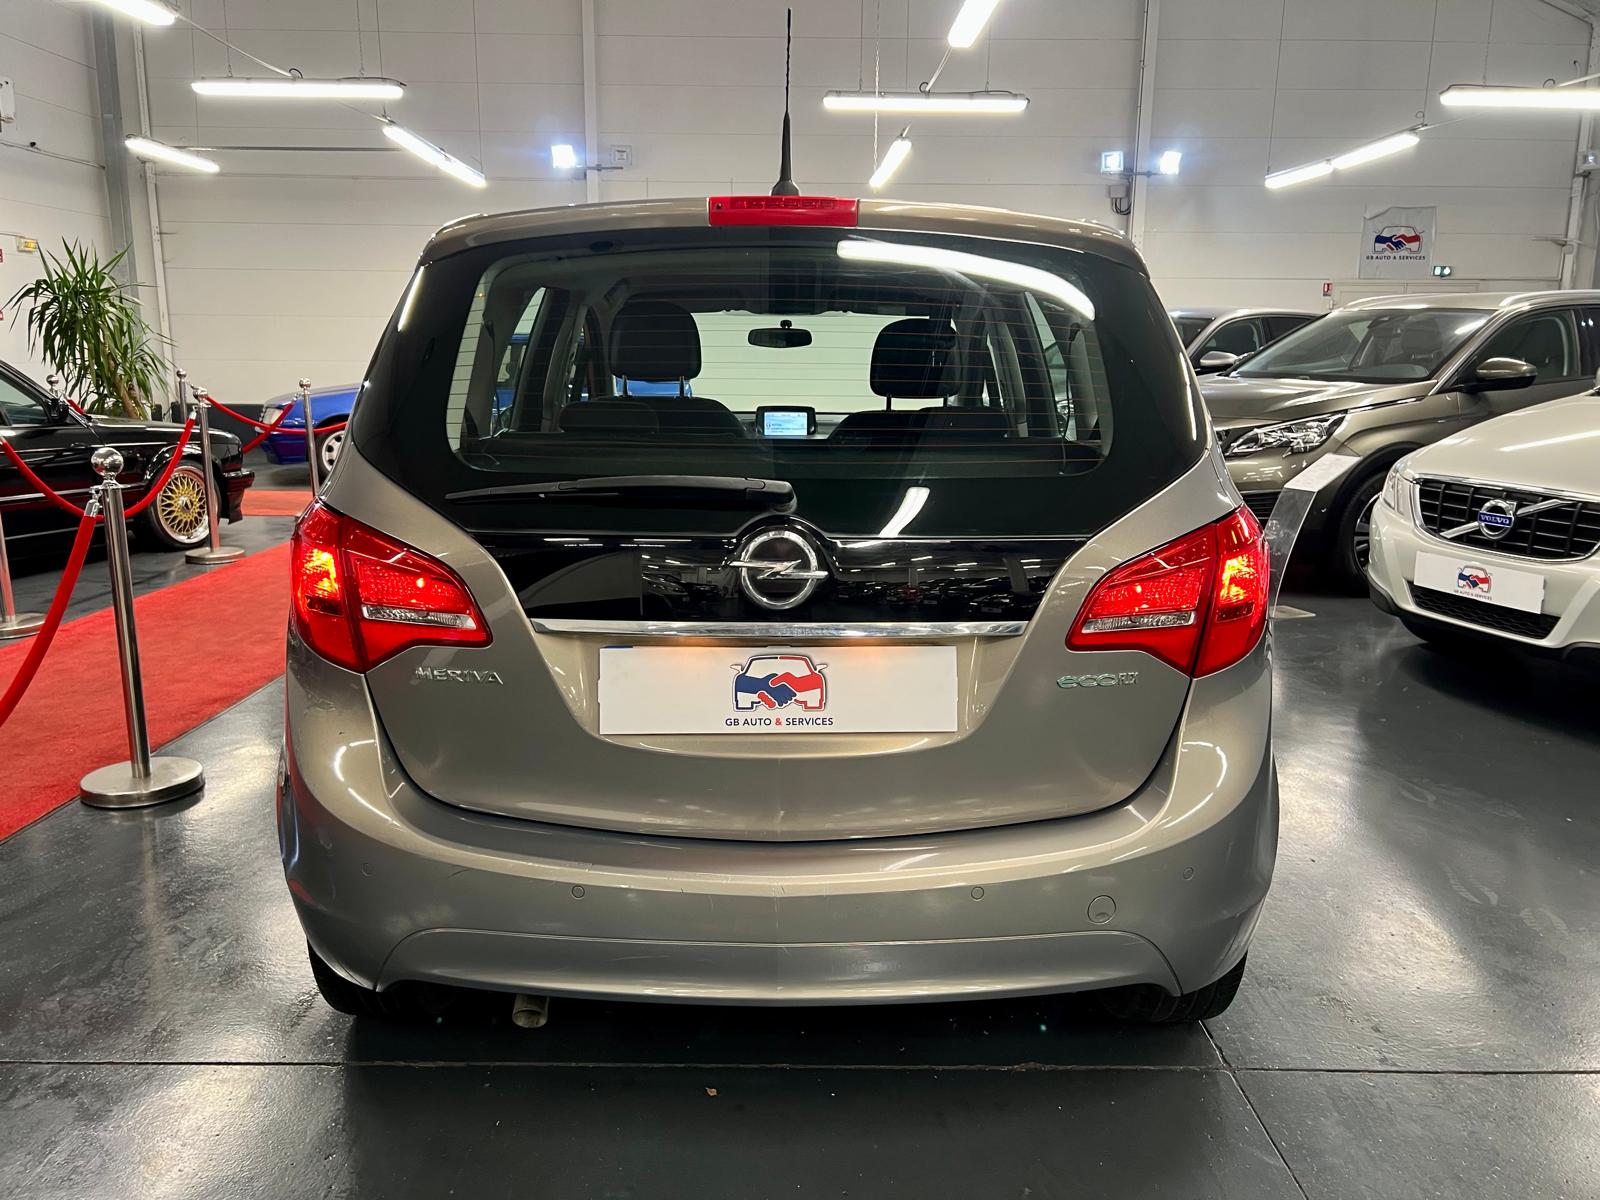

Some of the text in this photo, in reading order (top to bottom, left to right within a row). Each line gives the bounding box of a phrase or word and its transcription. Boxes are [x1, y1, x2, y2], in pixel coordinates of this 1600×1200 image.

[1480, 514, 1510, 524] VOLVO
[415, 667, 504, 685] MERIVA
[725, 717, 834, 726] GB AUTO & SERVICES
